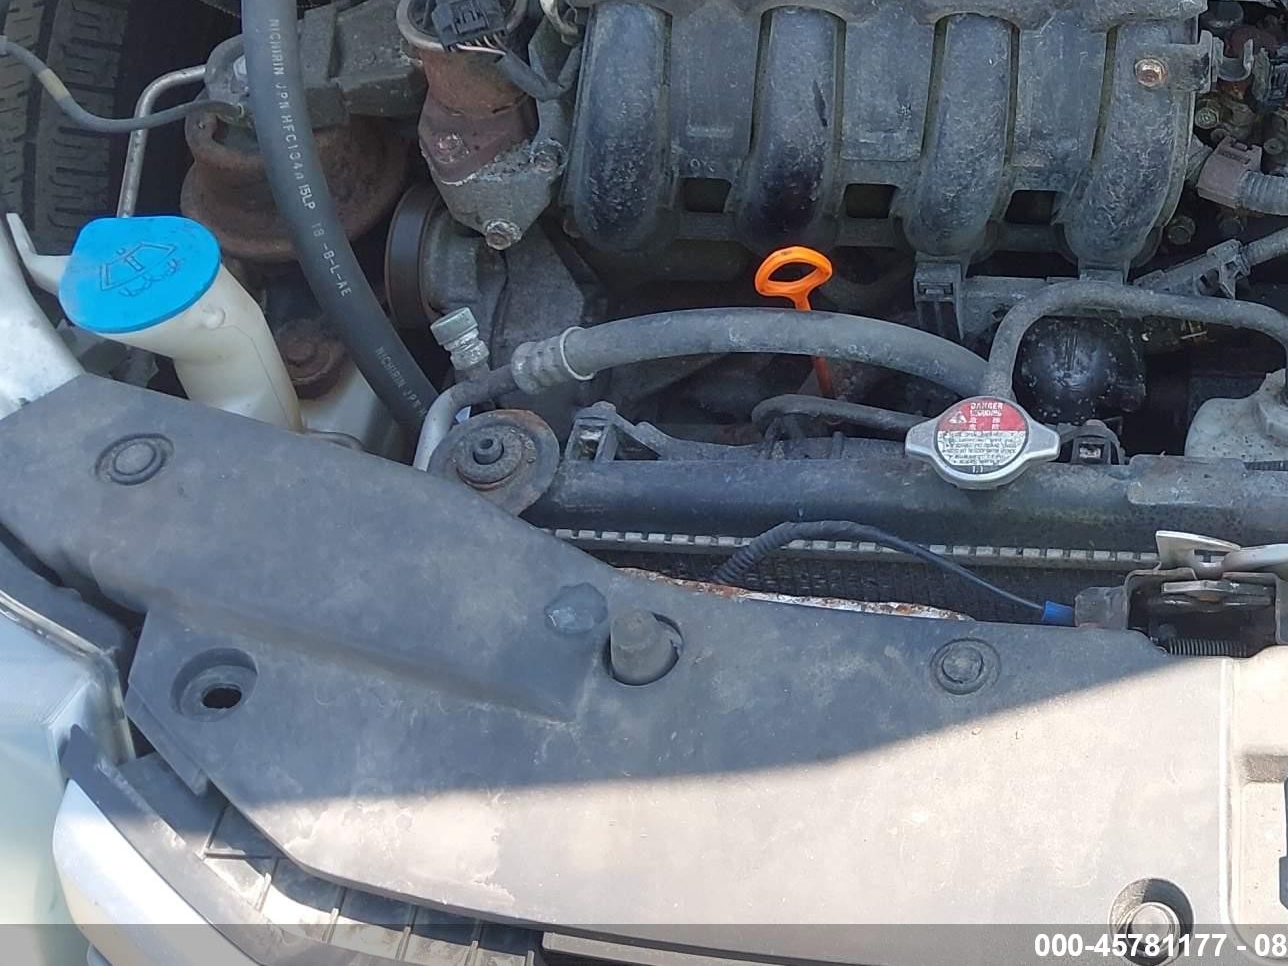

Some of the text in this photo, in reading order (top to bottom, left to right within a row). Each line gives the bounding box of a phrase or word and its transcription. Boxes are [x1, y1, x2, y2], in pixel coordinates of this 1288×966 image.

[268, 18, 285, 76] NICHIRIN
[275, 84, 290, 109] JPN
[298, 184, 316, 211] 15LP
[970, 402, 1004, 410] DANGER
